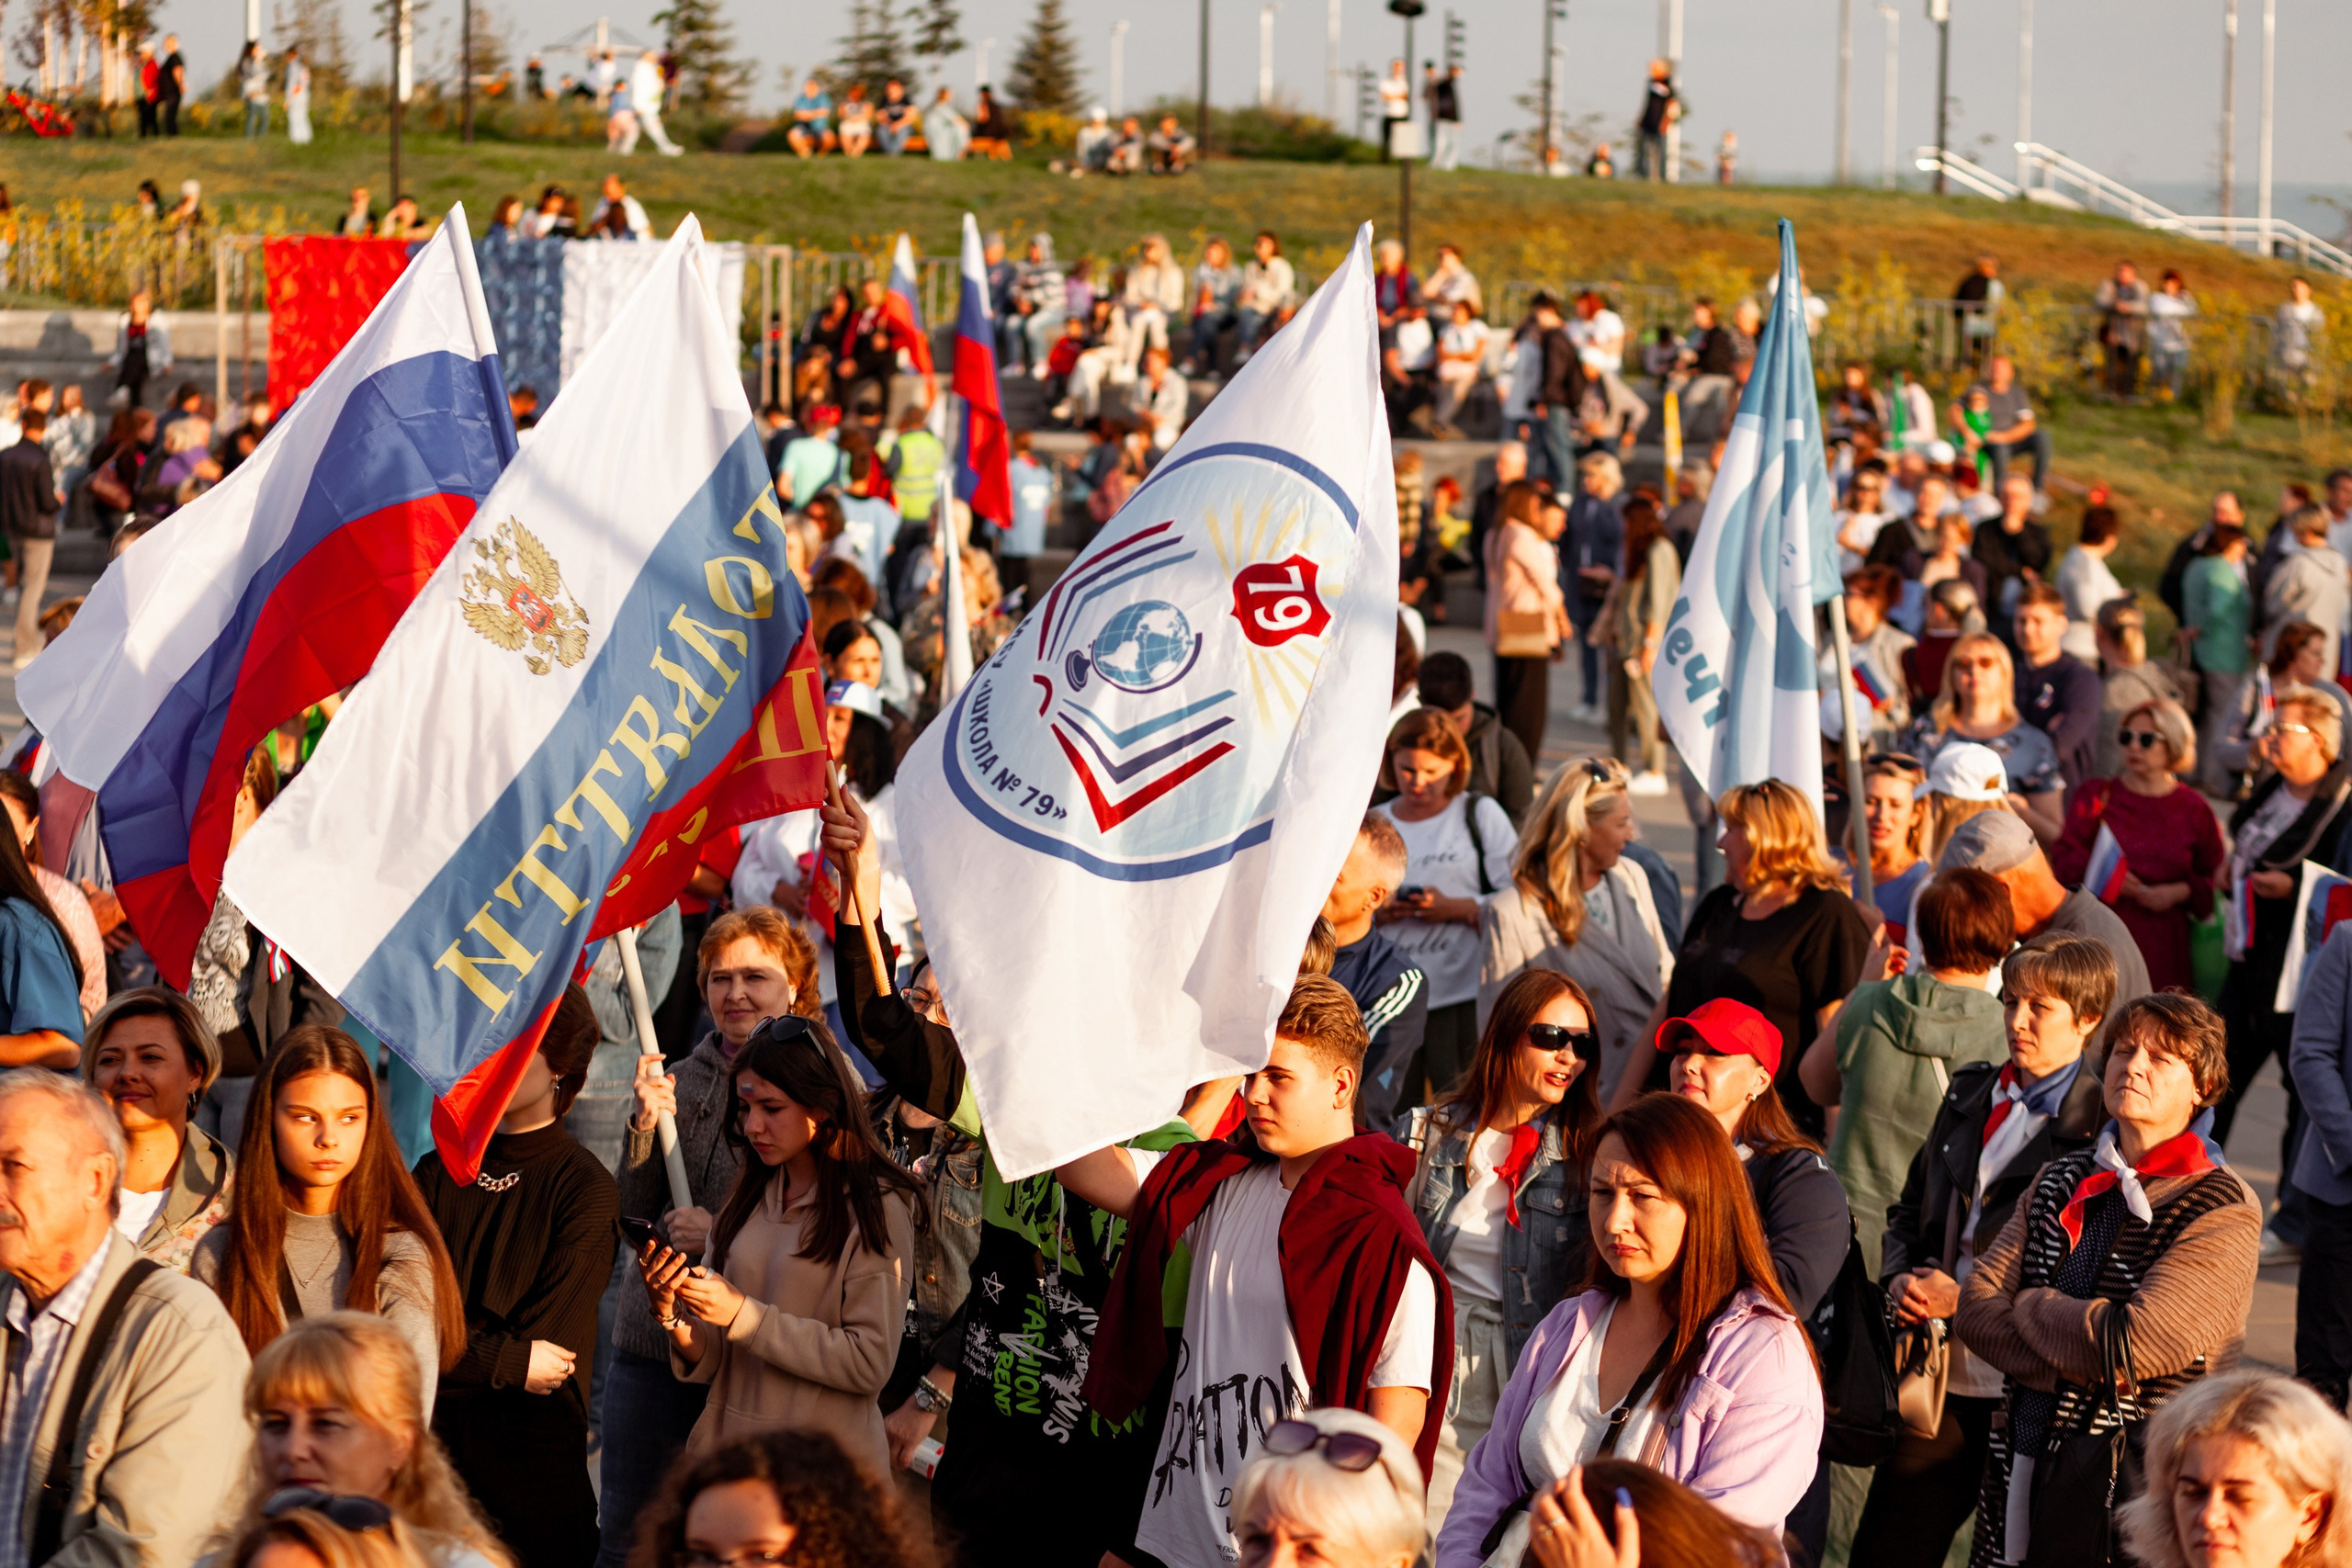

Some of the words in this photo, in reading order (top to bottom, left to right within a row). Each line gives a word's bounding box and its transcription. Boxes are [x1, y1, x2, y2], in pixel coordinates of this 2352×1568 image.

[1247, 565, 1312, 632] 79
[990, 767, 1022, 792] №
[1019, 785, 1068, 819] 79»
[1014, 1293, 1047, 1415] FASHION
